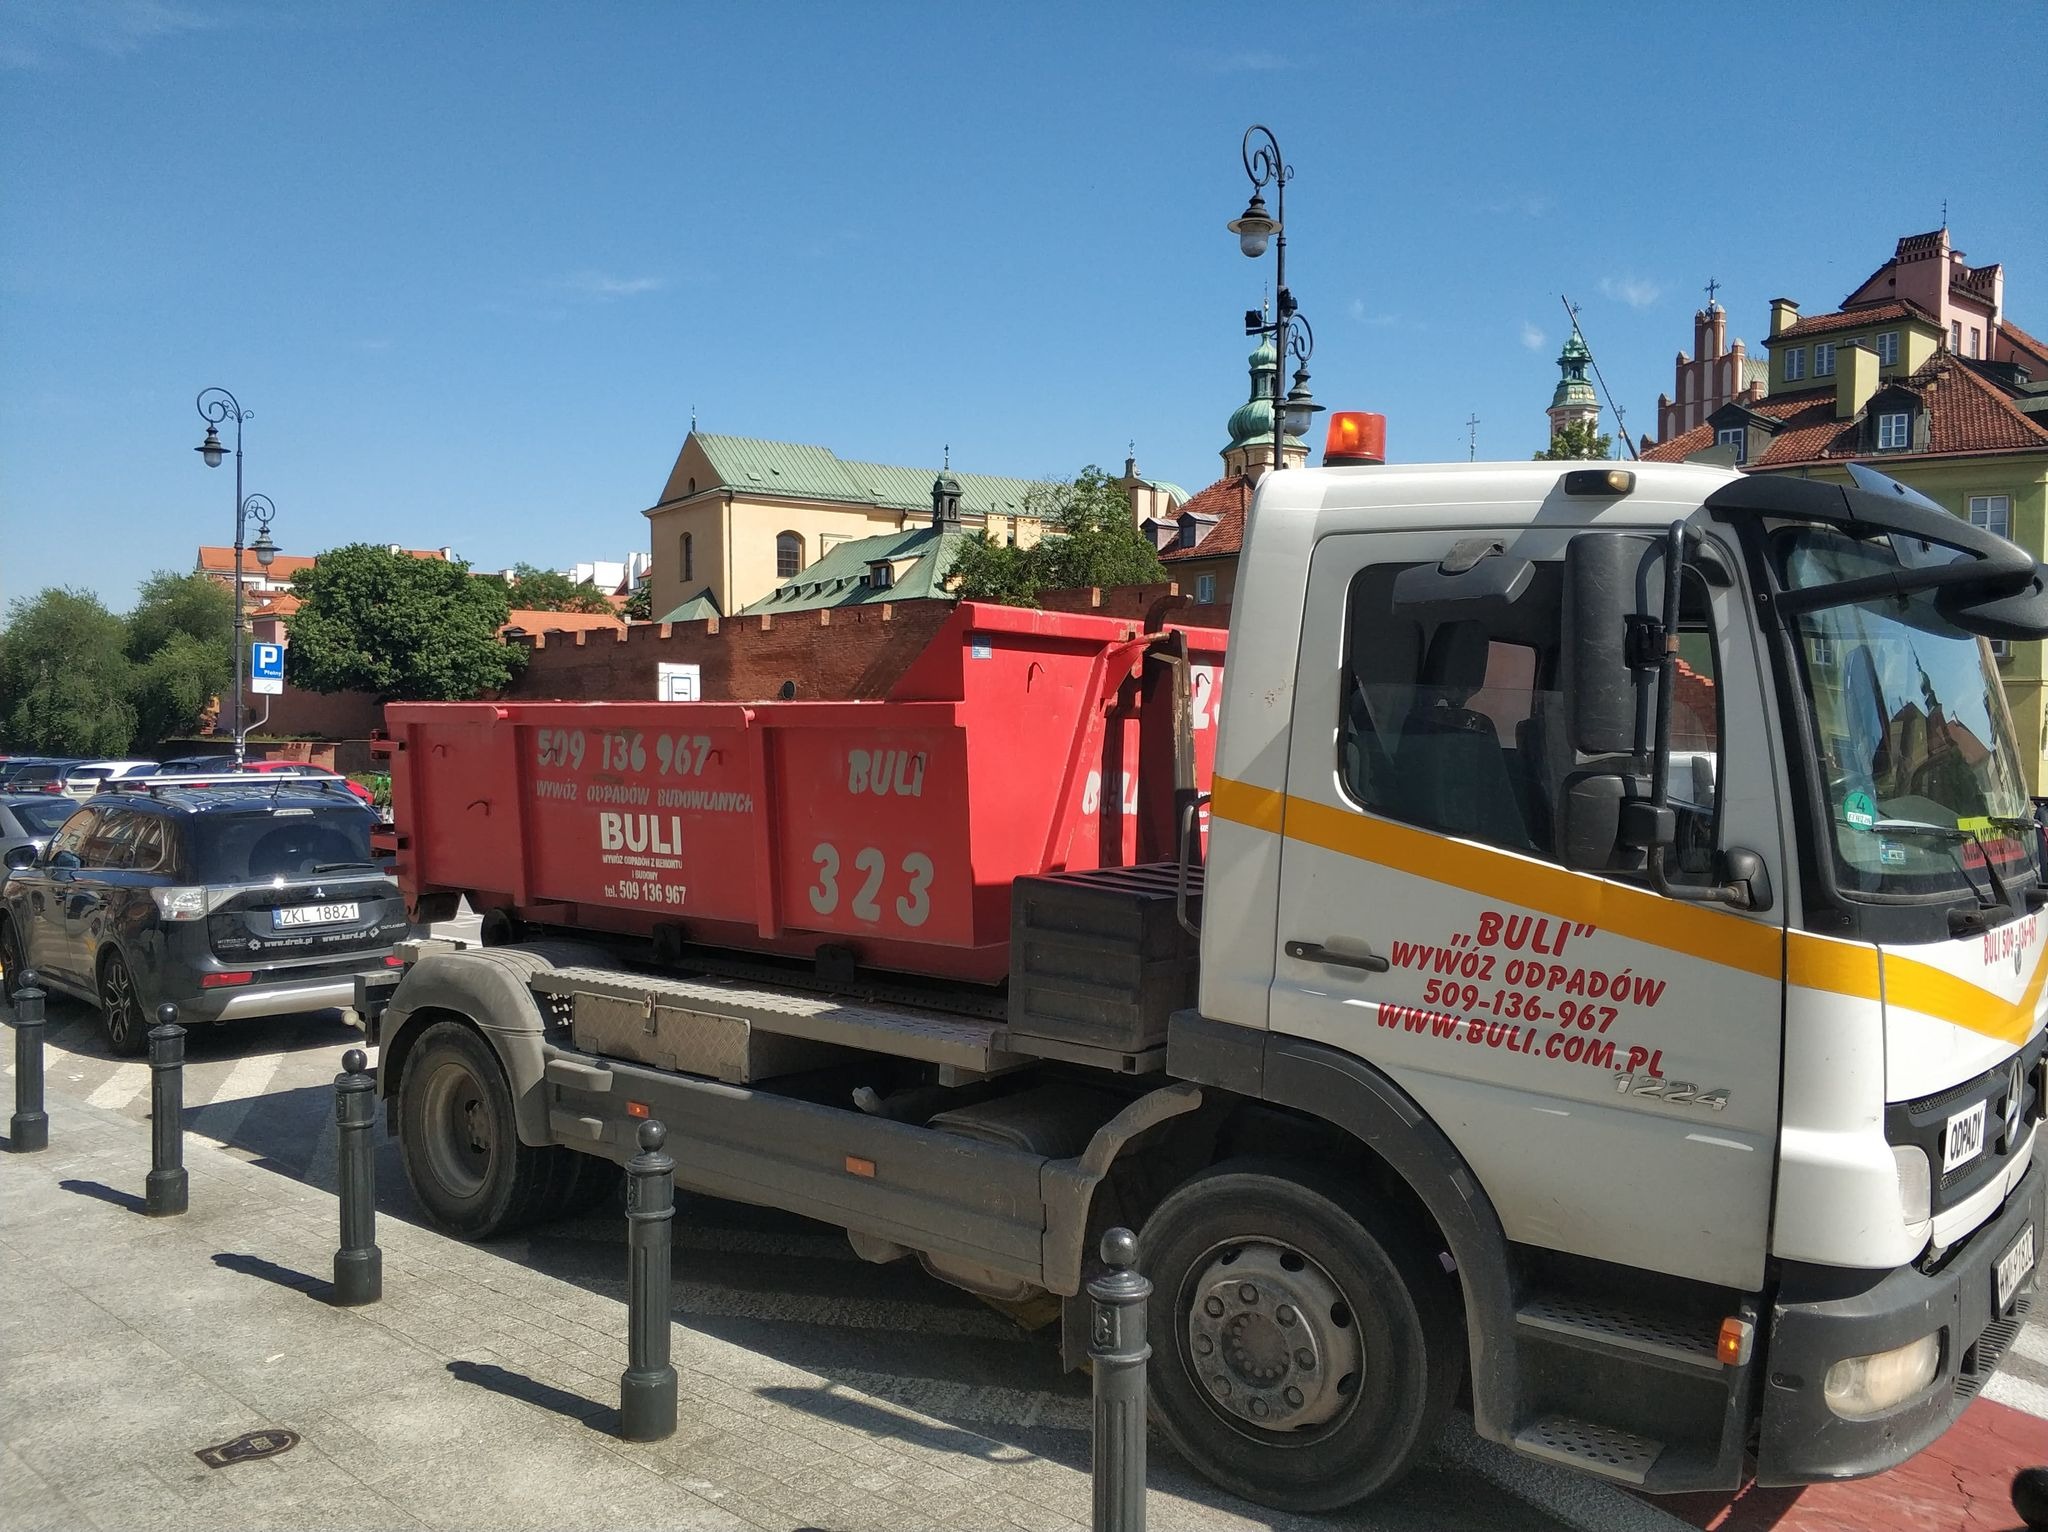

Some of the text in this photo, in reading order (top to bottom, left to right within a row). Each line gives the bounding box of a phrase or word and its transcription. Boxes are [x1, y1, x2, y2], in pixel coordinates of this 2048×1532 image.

[260, 646, 278, 669] P
[537, 729, 711, 776] 509 136 967
[847, 749, 927, 797] BULI
[536, 779, 753, 813] WYWÓZ ODPADÓW BUDOWLANYCH
[1856, 795, 1866, 812] 4
[600, 812, 682, 855] BULI
[605, 880, 687, 905] tel. 509 136 967
[282, 904, 356, 924] ZKL 18821
[1984, 932, 2000, 966] BULI
[1392, 941, 1666, 1007] WYWÓZ ODPADÓW
[1423, 979, 1619, 1033] 509-136-967
[1377, 1003, 1665, 1078] WWW.BULI.COM.PL
[1614, 1072, 1732, 1111] 1224
[1949, 1109, 1984, 1161] ODPADY
